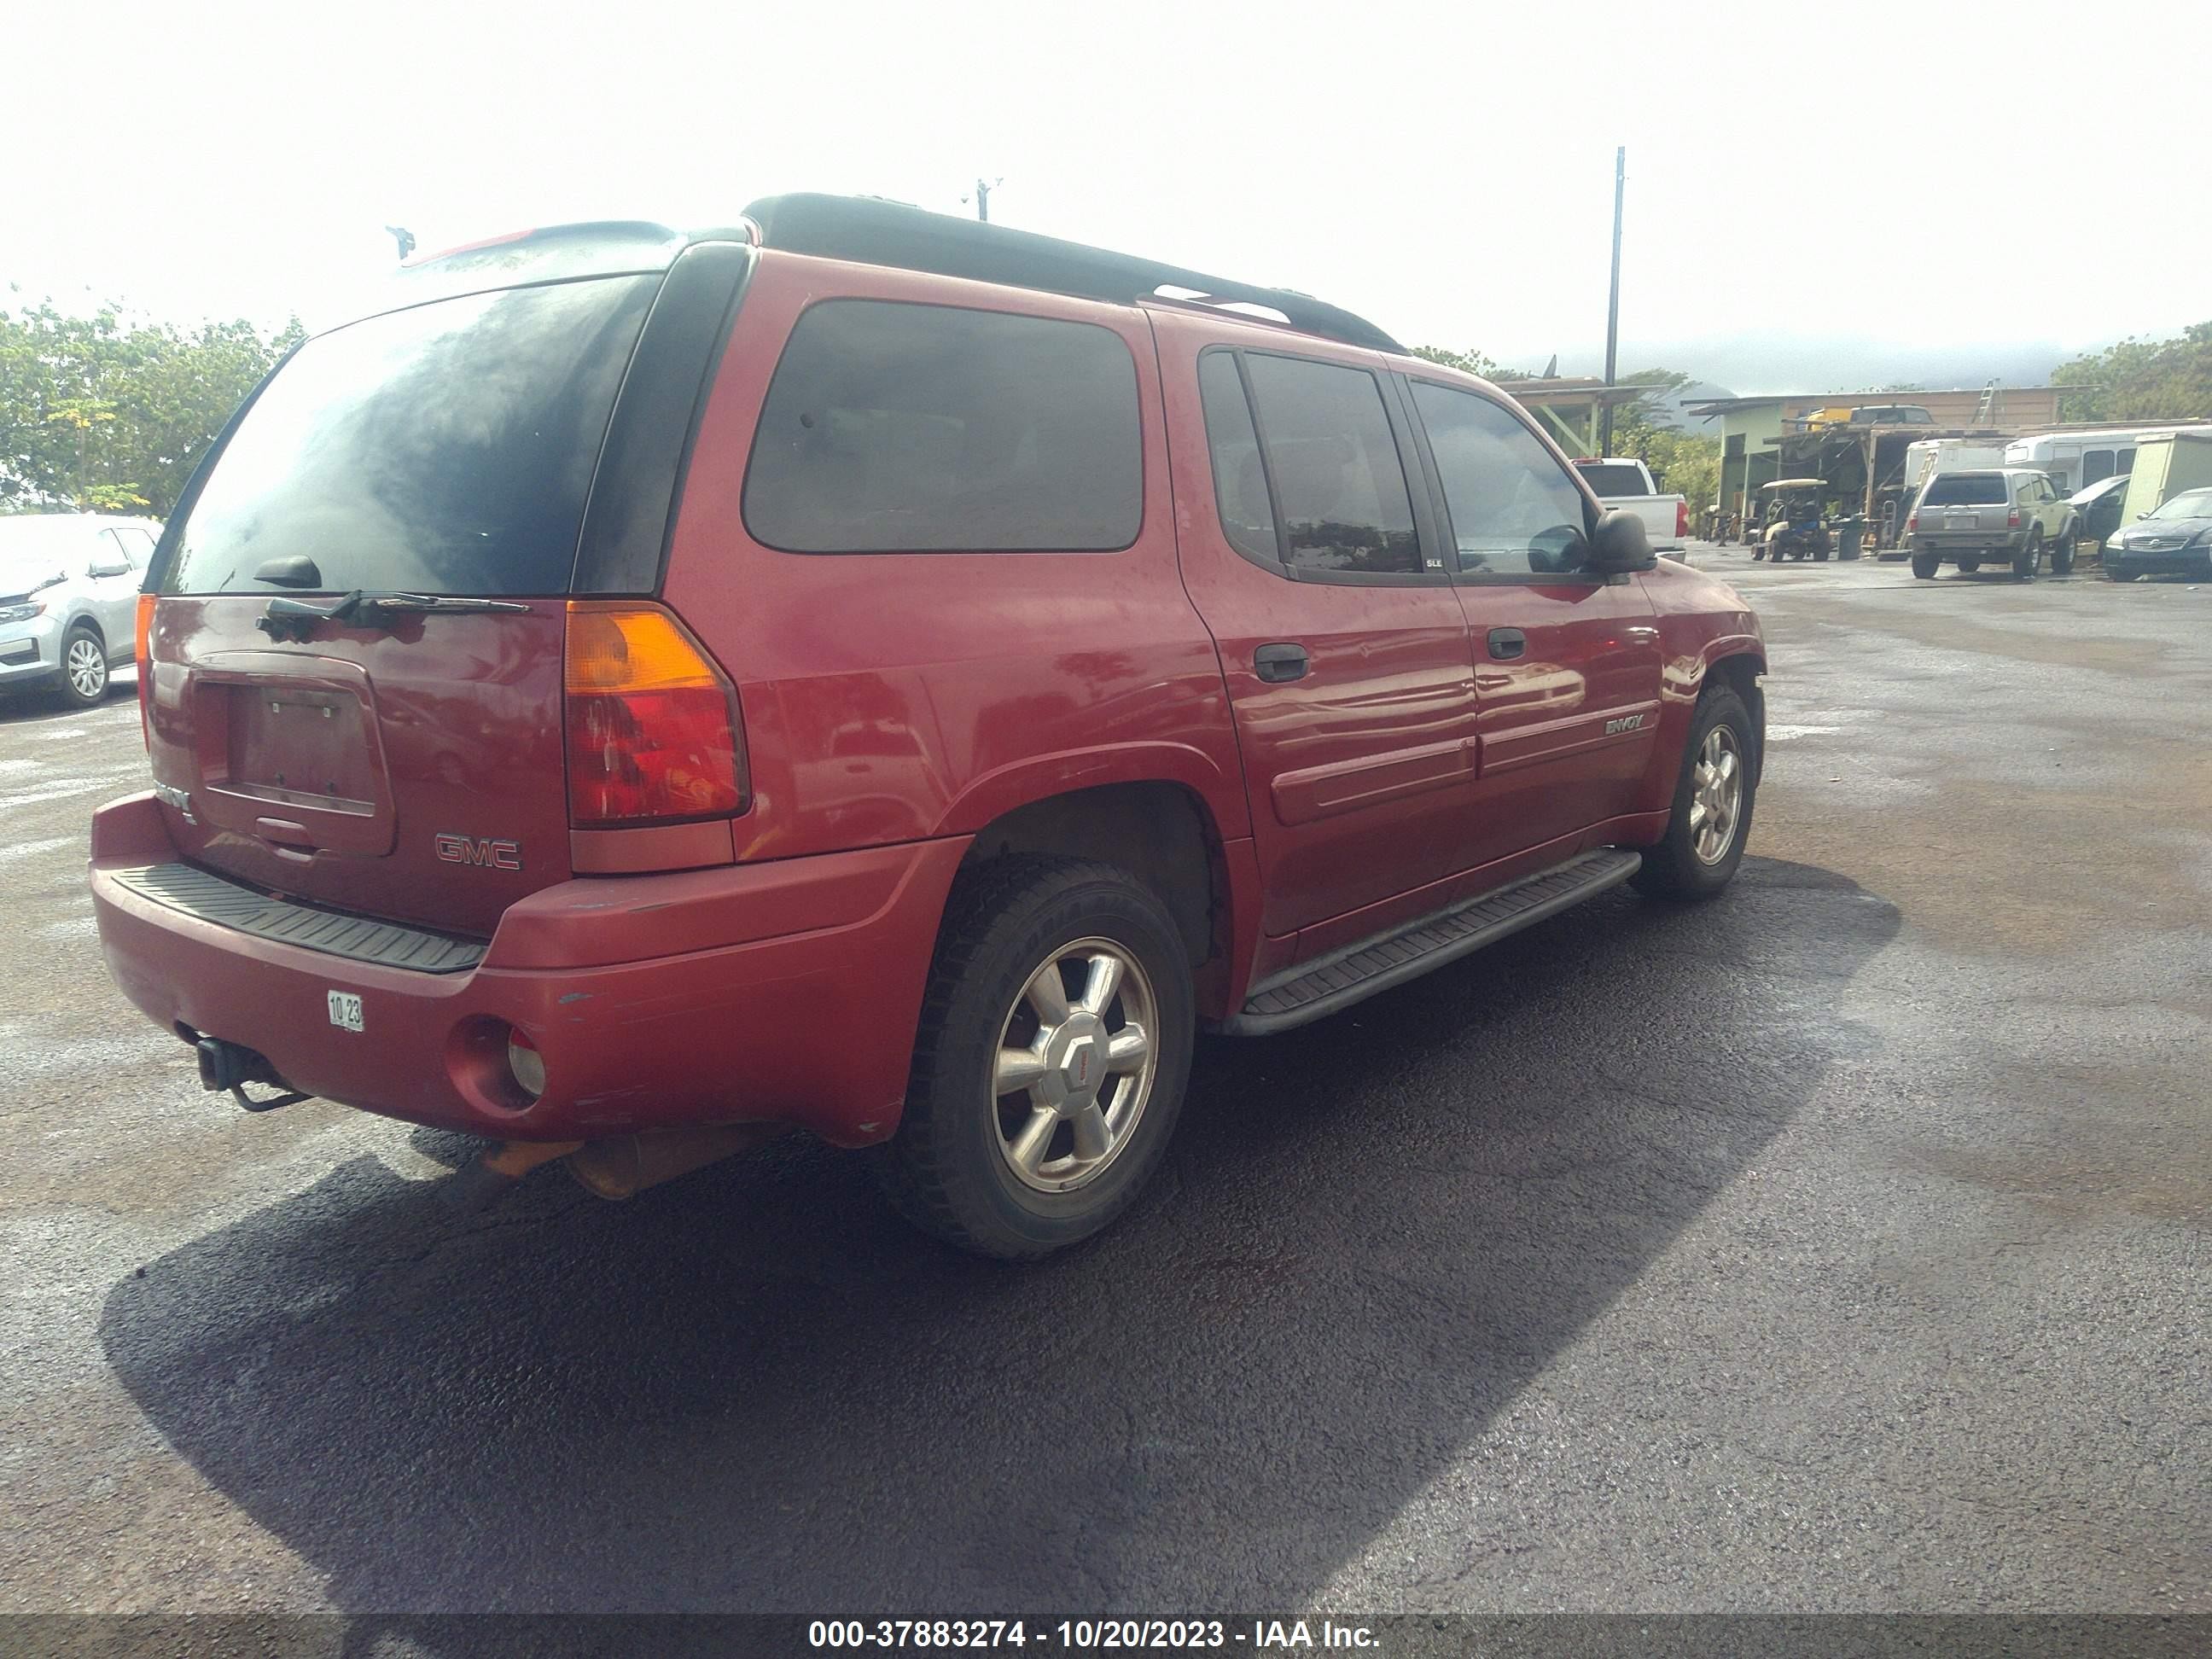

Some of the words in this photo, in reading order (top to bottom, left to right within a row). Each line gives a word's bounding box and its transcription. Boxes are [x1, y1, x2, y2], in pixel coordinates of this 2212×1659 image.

[1426, 559, 1443, 568] SLE
[1604, 713, 1644, 736] ENVOY
[435, 832, 521, 870] GMC
[329, 995, 344, 1021] 10
[346, 998, 361, 1024] 23
